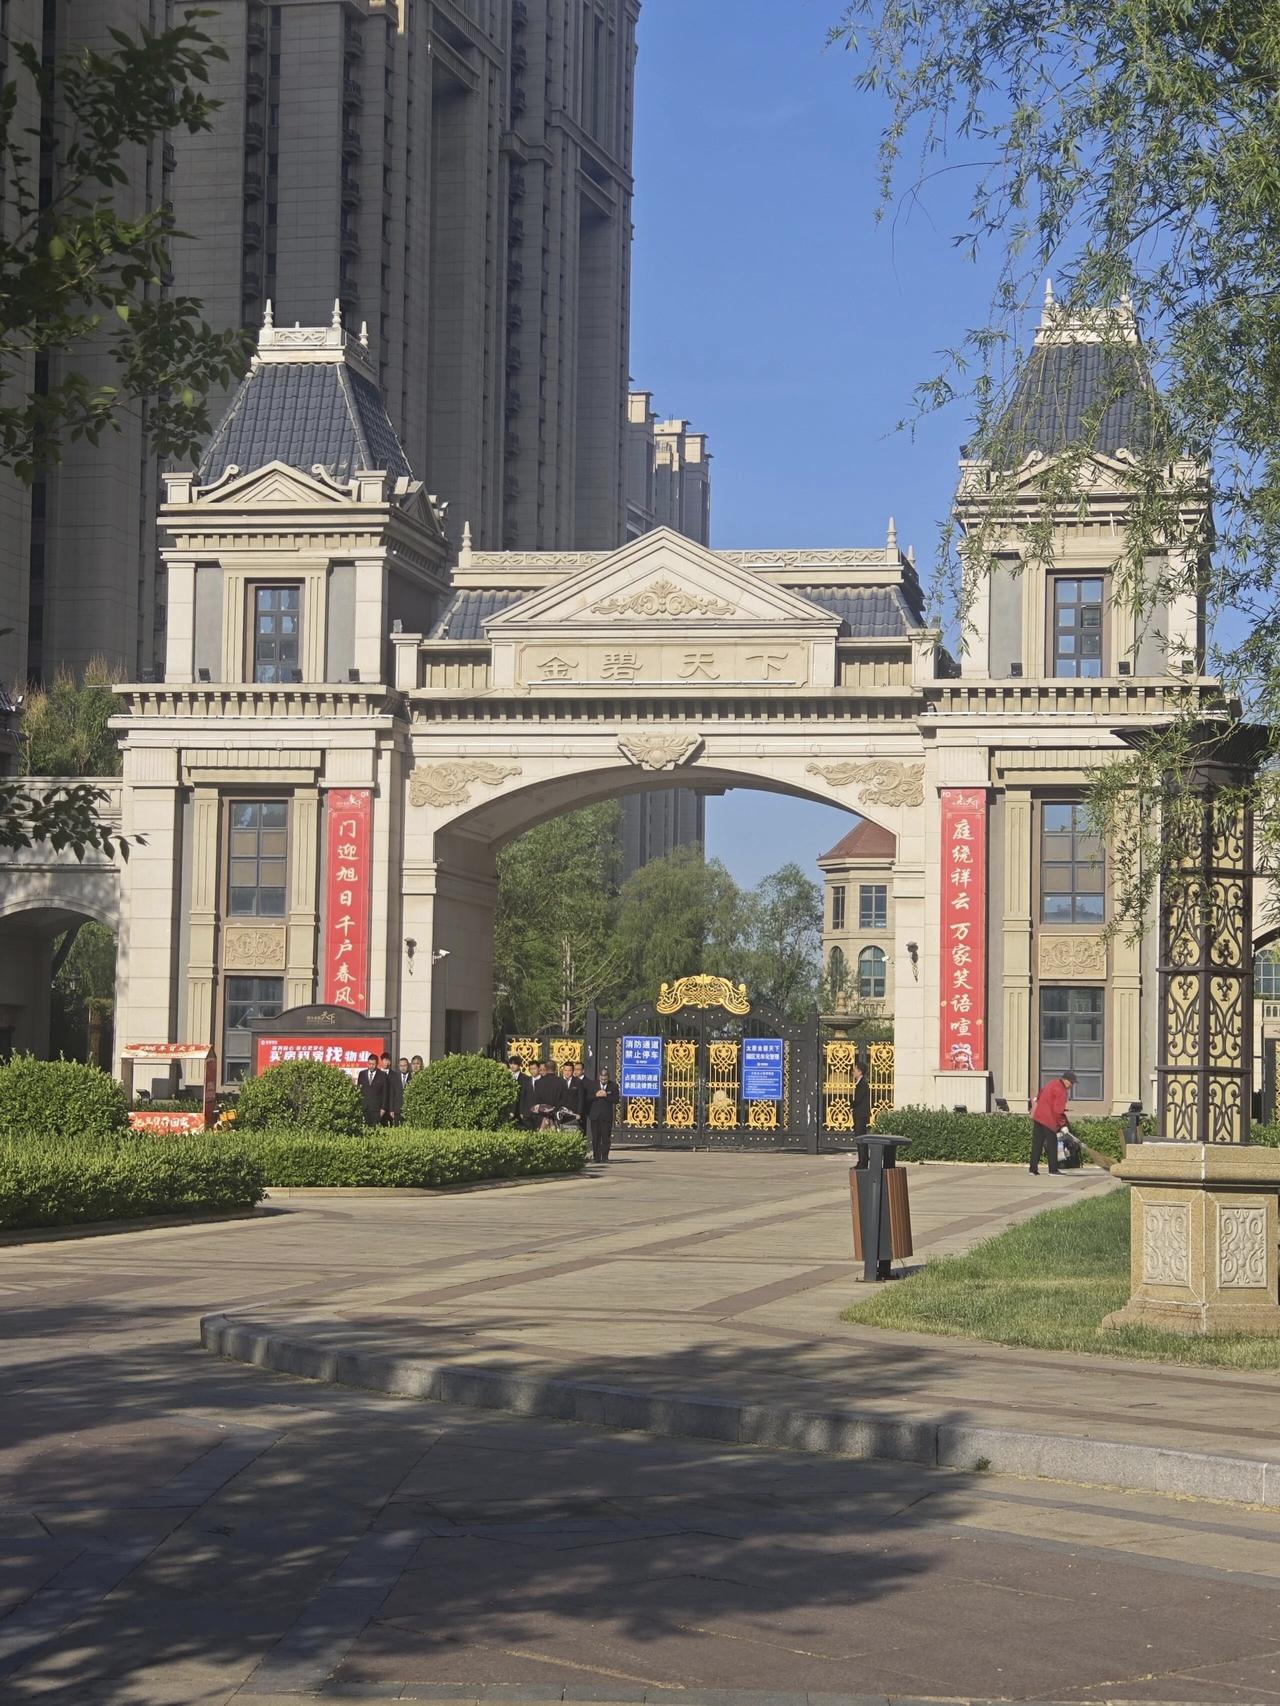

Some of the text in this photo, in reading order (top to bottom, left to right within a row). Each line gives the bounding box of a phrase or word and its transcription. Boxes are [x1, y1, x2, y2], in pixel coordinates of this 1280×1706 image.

[537, 652, 788, 681] 金碧天下
[334, 819, 359, 1005] 门迎旭日千户春风
[625, 1039, 659, 1049] 消防通道
[625, 1050, 659, 1059] 禁止停车
